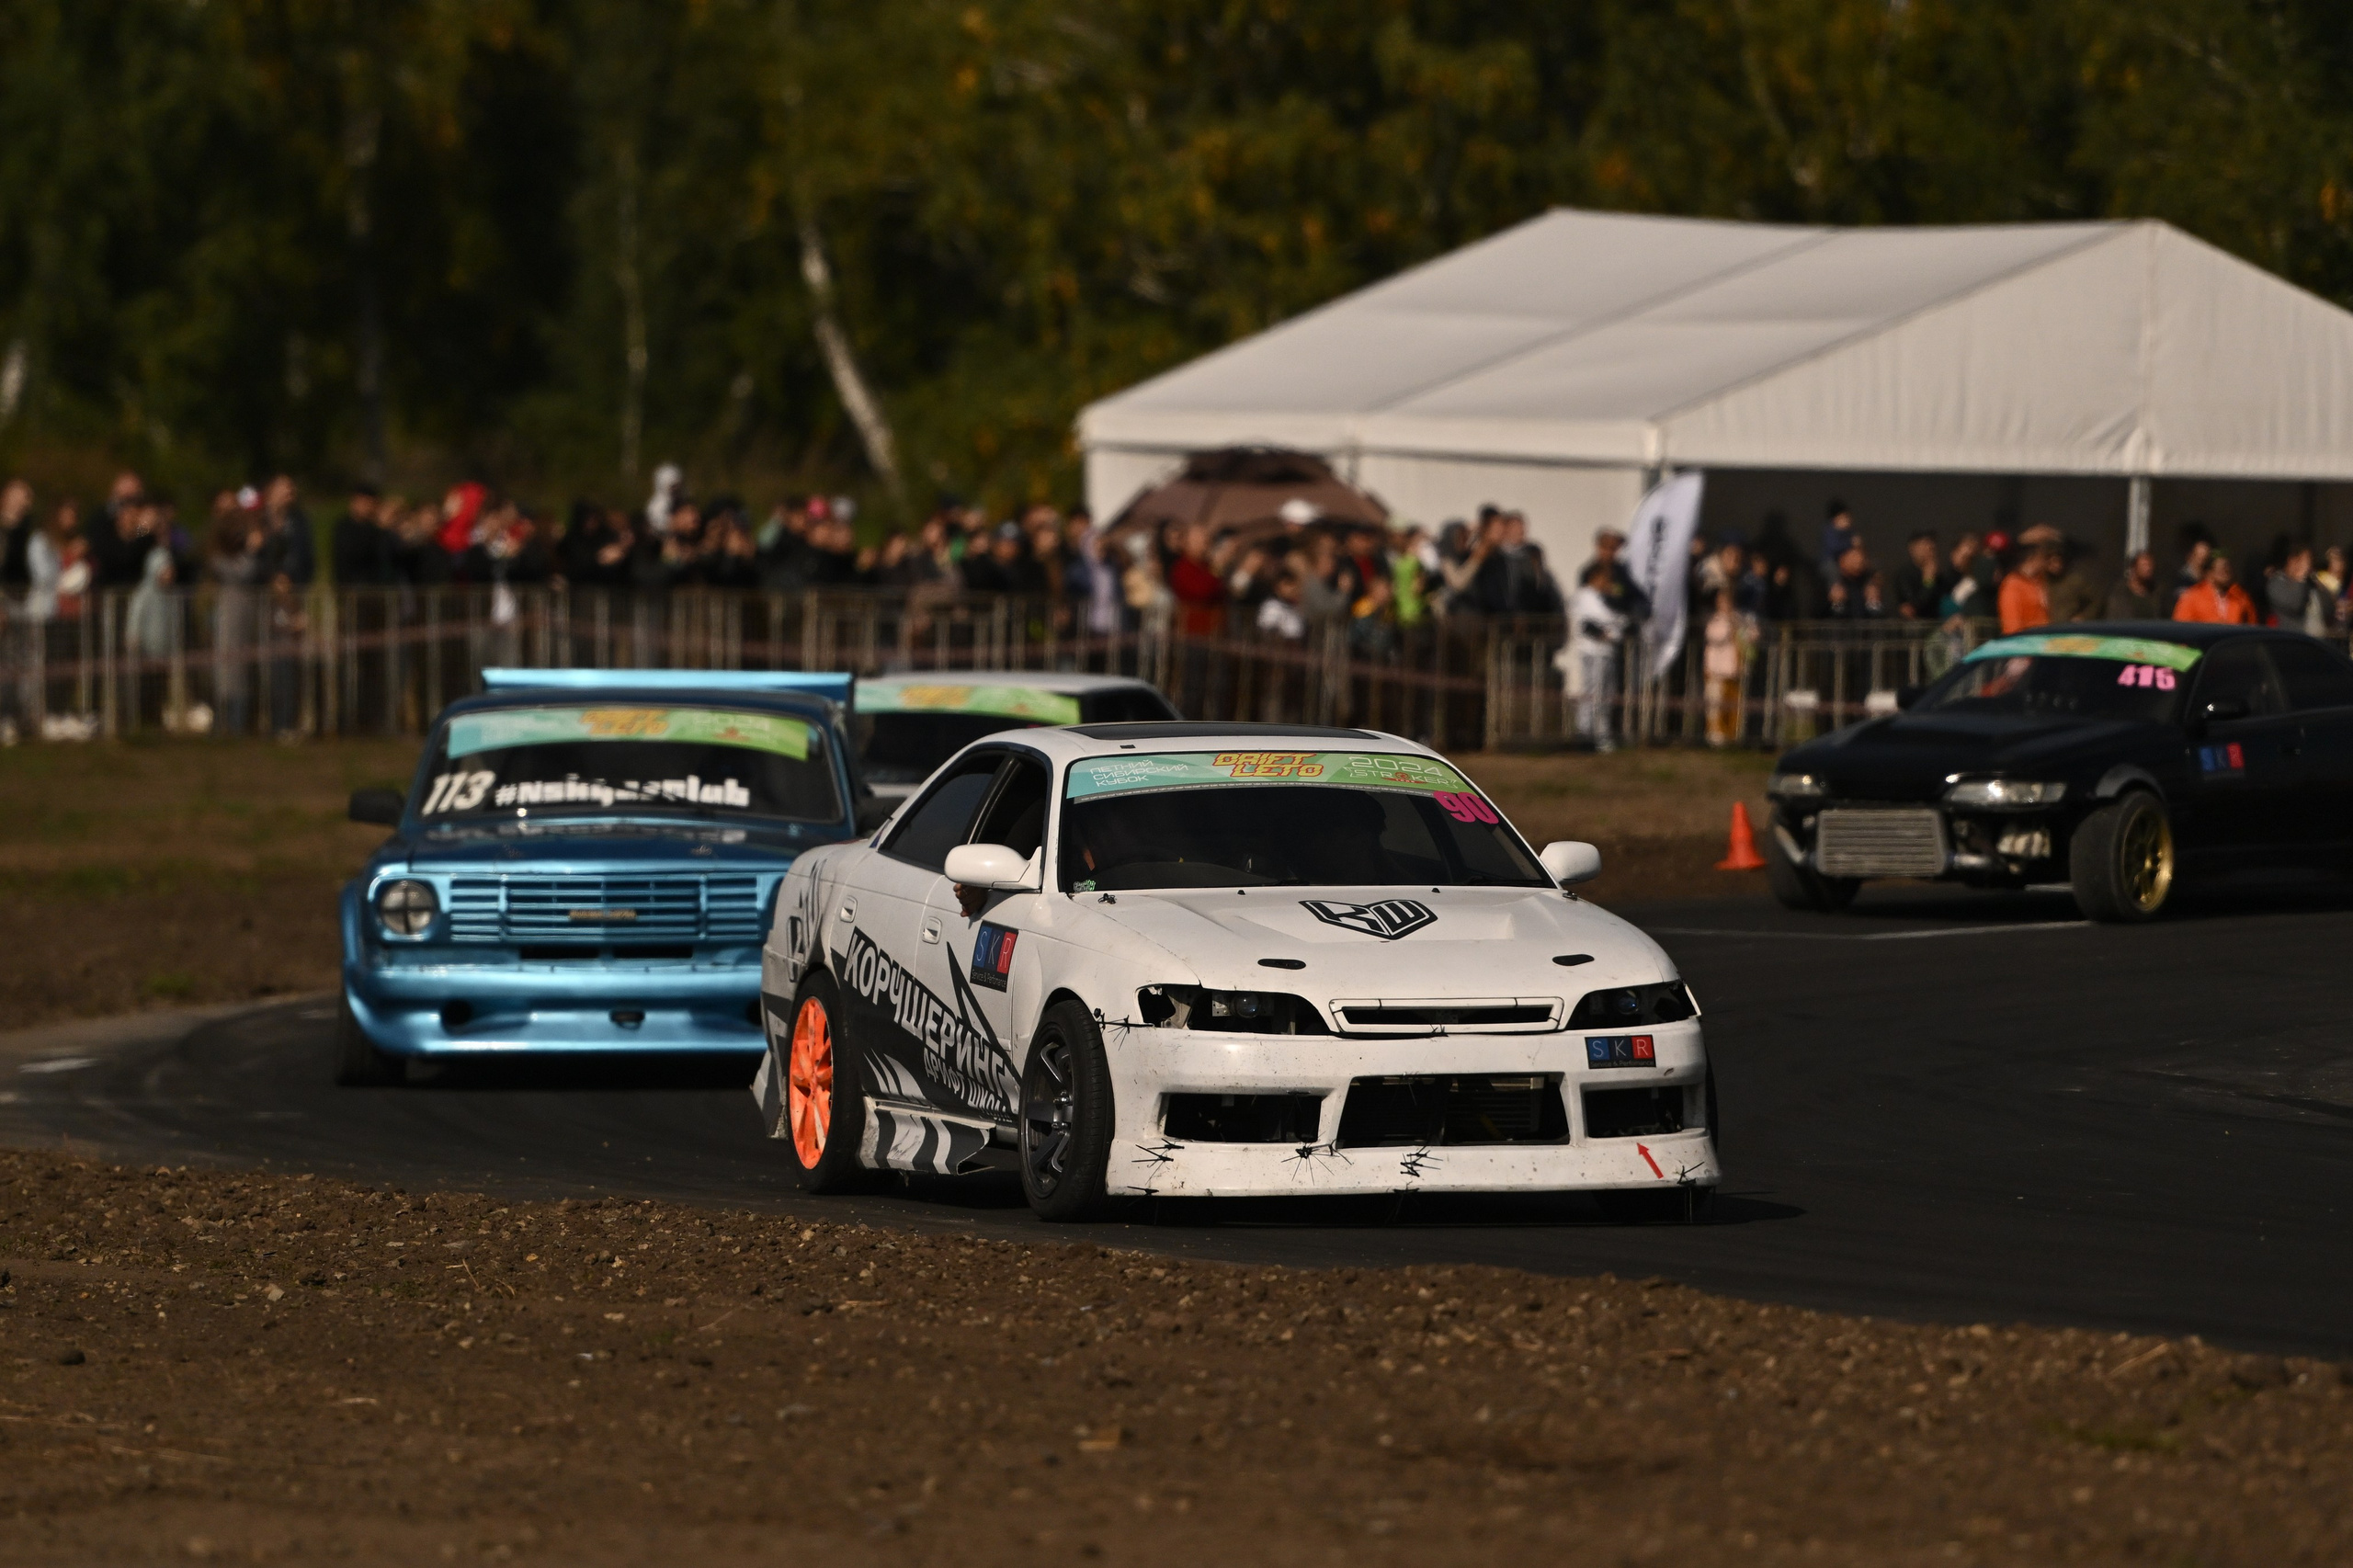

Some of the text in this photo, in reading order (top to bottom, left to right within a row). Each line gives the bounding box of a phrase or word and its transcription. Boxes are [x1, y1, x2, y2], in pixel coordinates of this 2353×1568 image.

[1090, 759, 1154, 774] ЛЕТНИЙ
[1212, 753, 1317, 766] DRIFT
[1348, 756, 1442, 777] 2024
[1093, 764, 1188, 780] СИБИРСКИЙ
[1230, 764, 1324, 777] LETO
[1096, 775, 1149, 787] КУБОК
[422, 770, 496, 816] 113
[1433, 790, 1499, 824] 90
[976, 931, 1012, 968] SKR
[844, 933, 1004, 1099] КОРЧШЕРИНГ
[1592, 1039, 1649, 1058] SKR
[924, 1048, 965, 1100] ДРИФТ
